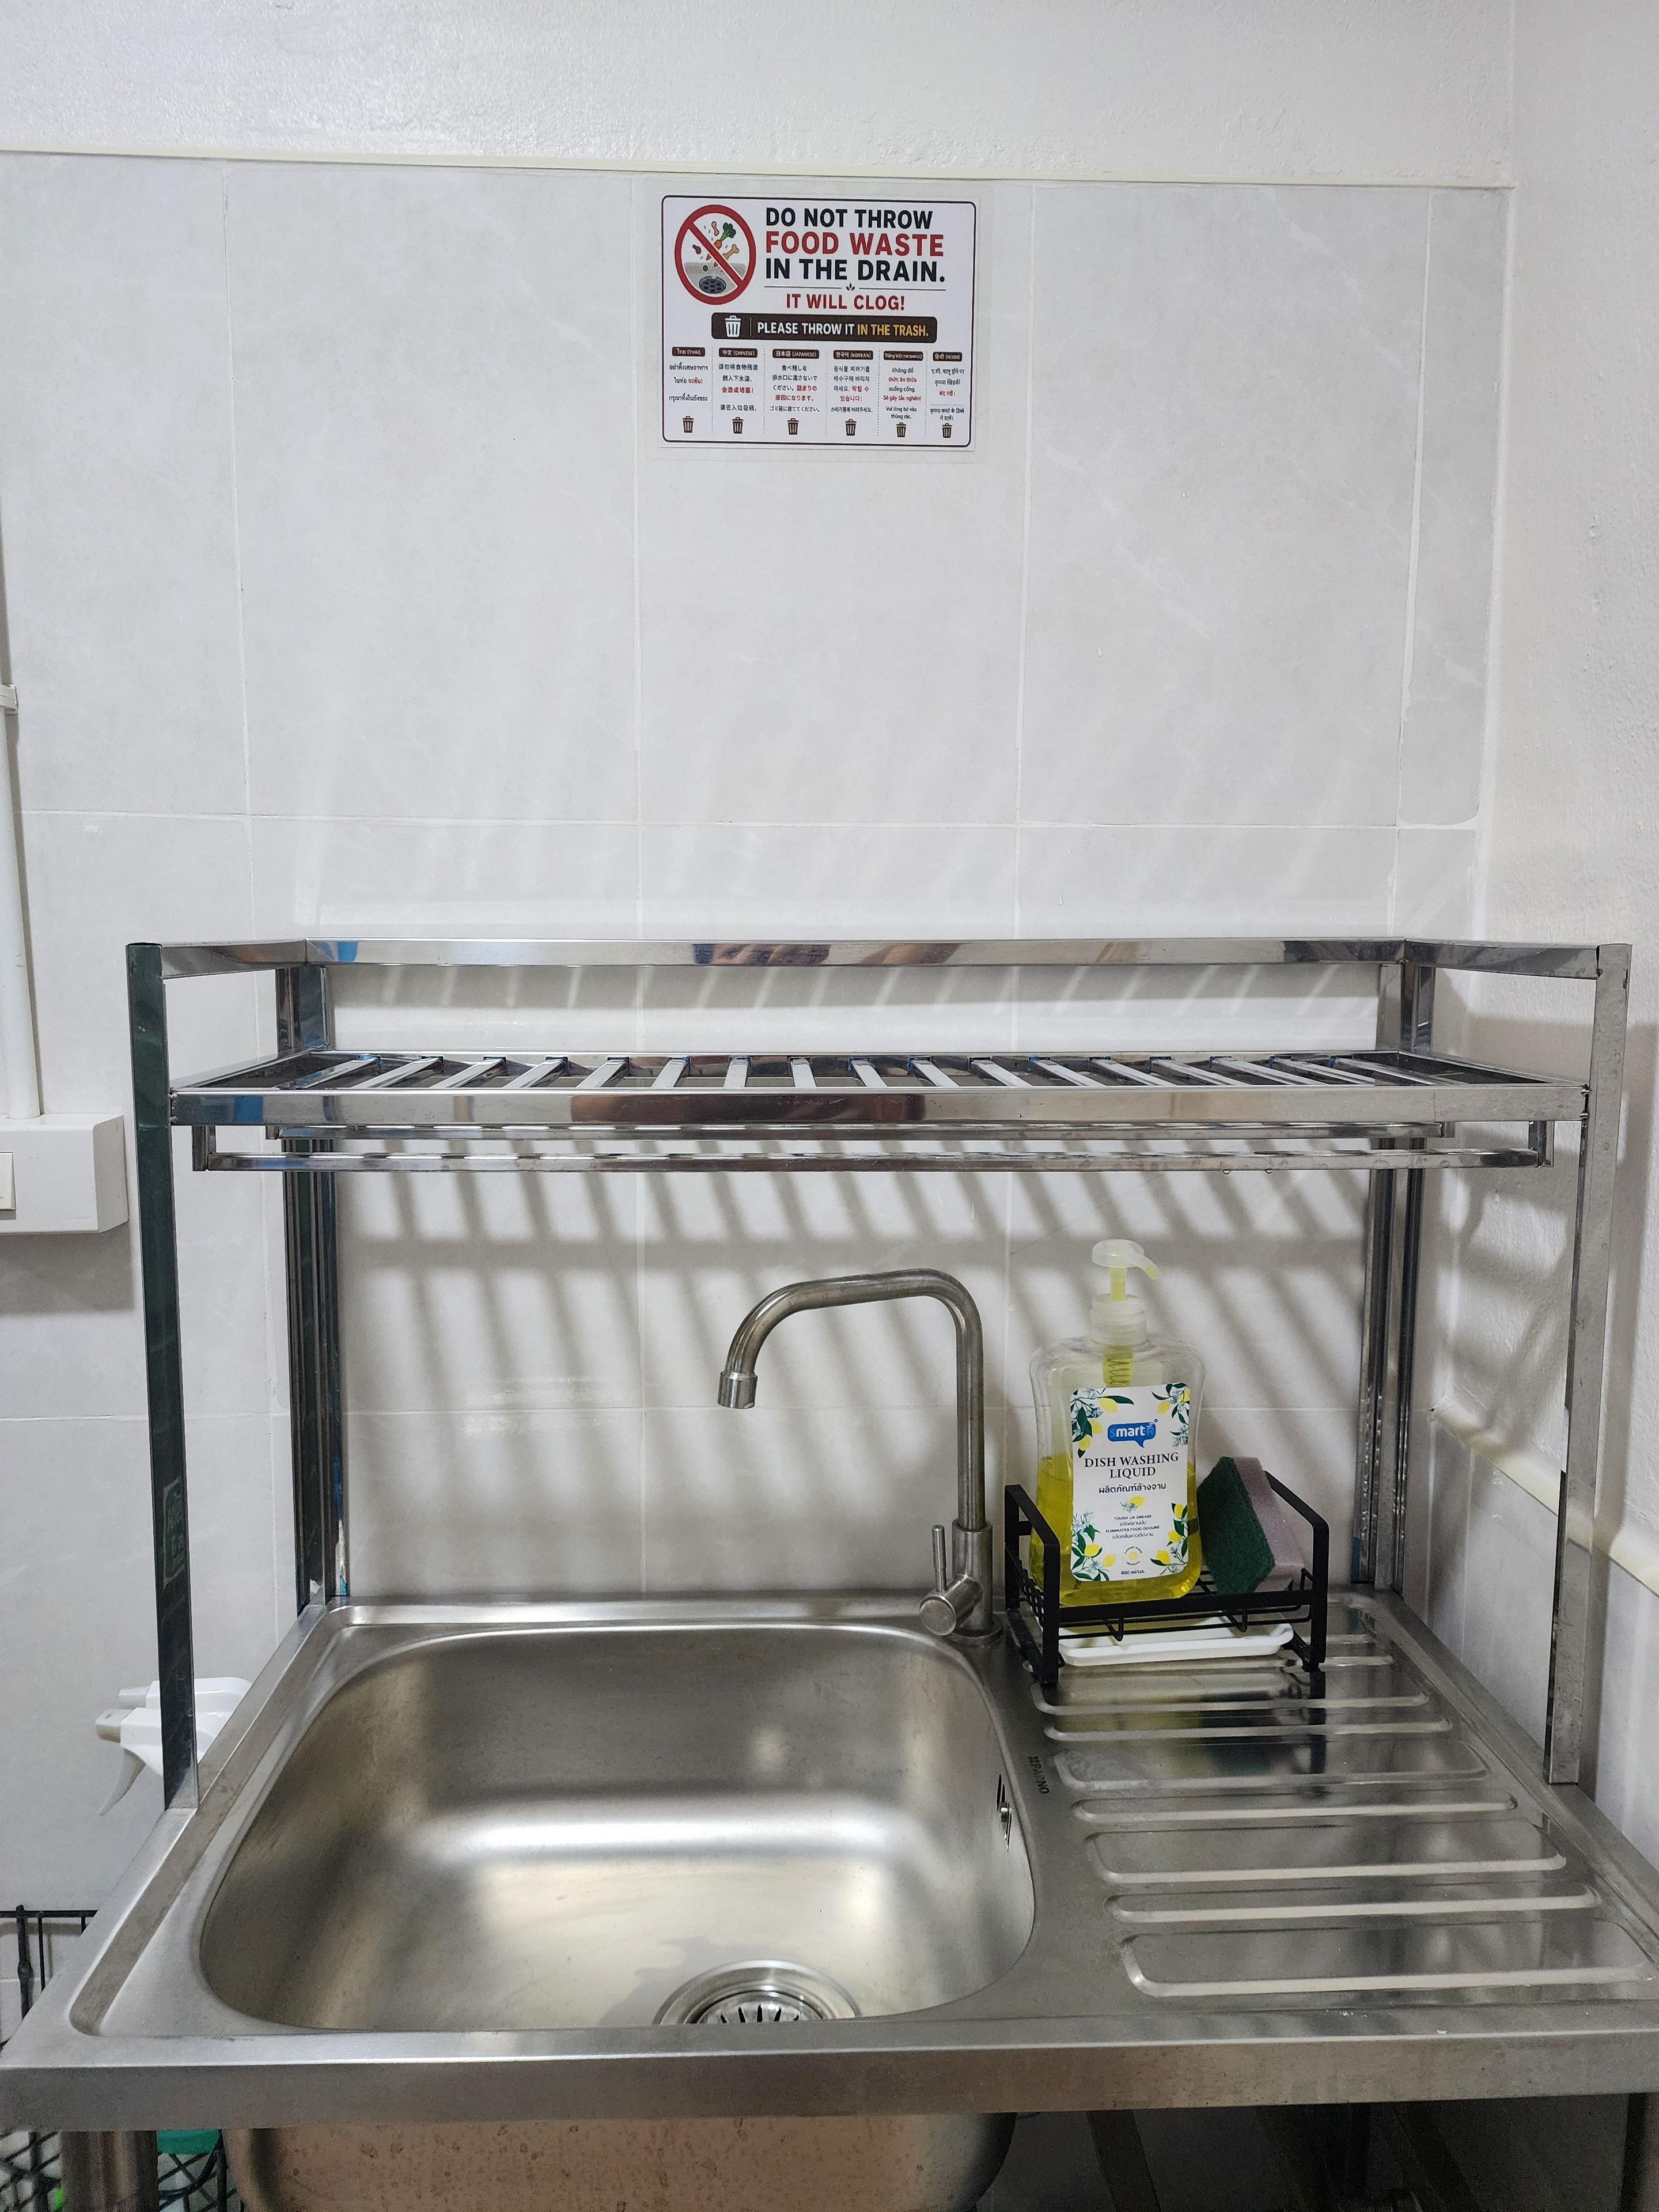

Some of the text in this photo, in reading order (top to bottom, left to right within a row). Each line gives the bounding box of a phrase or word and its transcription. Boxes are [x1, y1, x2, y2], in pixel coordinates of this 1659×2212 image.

[766, 207, 933, 229] DO NOT THROW
[766, 230, 944, 257] FOOD WASTE
[766, 257, 945, 283] IN THE DRAIN.
[786, 293, 905, 310] IT WILL CLOG!
[757, 321, 929, 336] PLEASE THROW IT IN THE TRASH.
[669, 362, 708, 370] อย่าทิ้งเศษอาหาร
[669, 392, 708, 403] กรุณาทิ้งในถังขยะ
[1084, 1452, 1179, 1468] DISH WASHING
[1109, 1467, 1156, 1479] LIQUID
[1099, 1482, 1166, 1494] ผลิตภัณฑ์ล้างจาน
